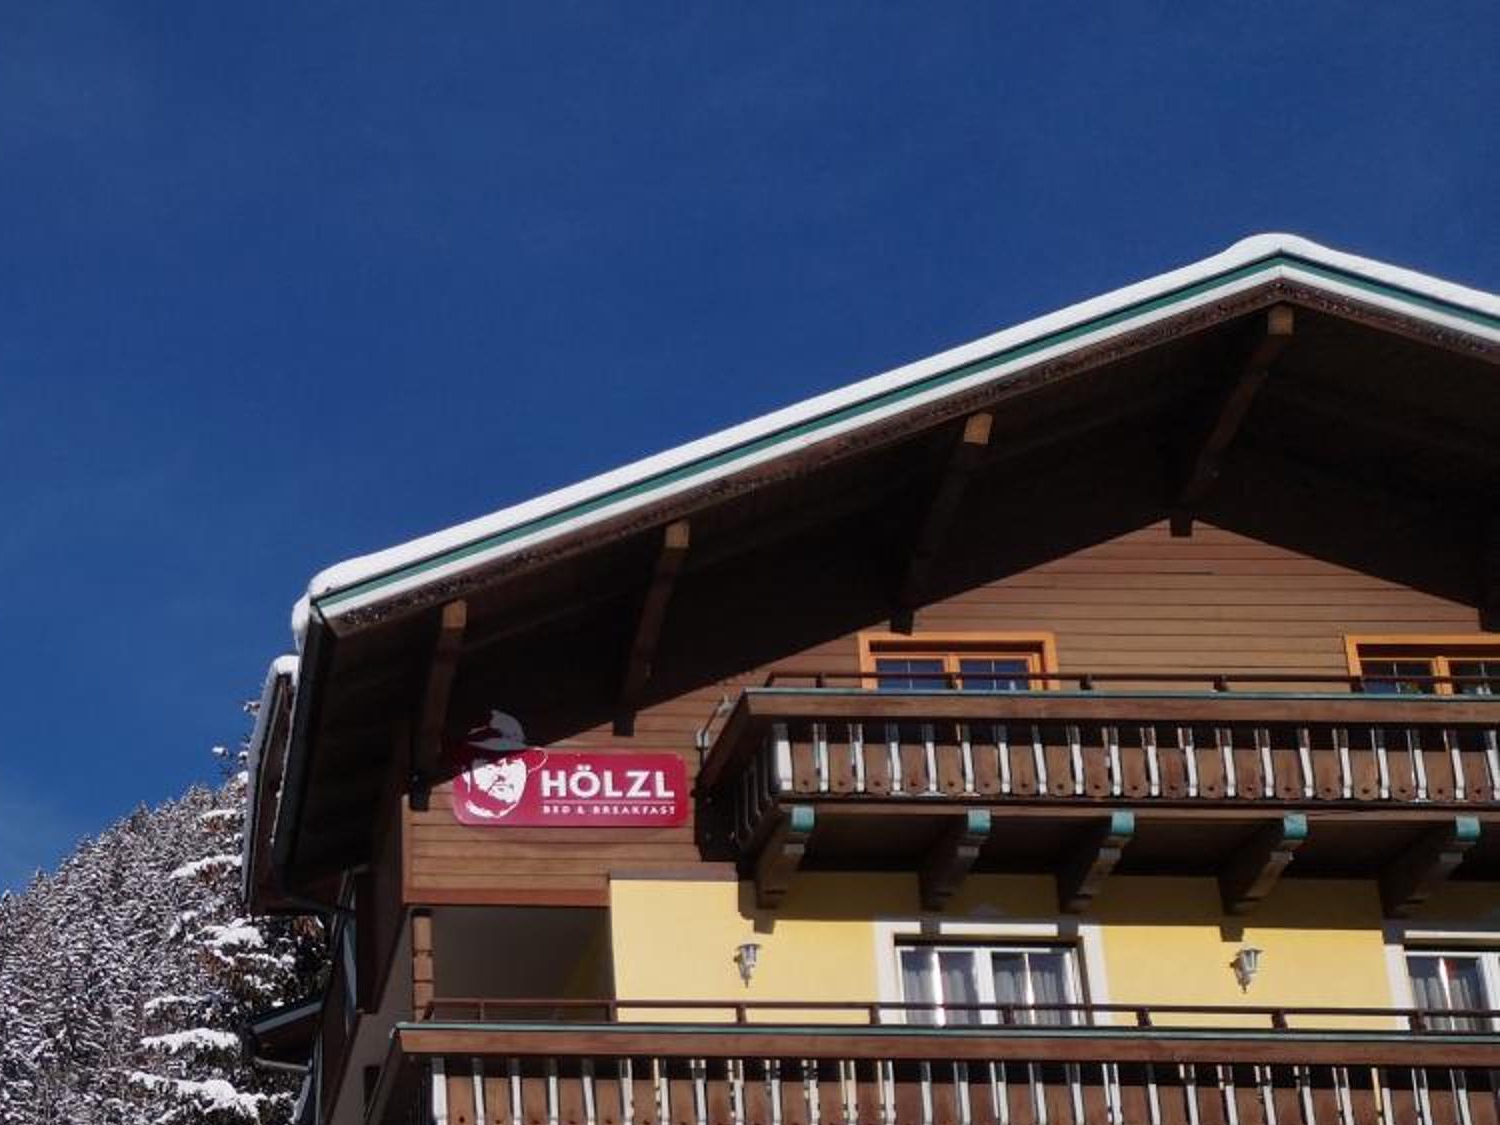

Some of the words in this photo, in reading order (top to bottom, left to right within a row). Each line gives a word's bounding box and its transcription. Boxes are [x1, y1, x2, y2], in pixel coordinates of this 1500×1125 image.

[541, 764, 675, 798] HÖLZL
[543, 805, 571, 814] BED
[593, 805, 675, 815] BREAKFAST
